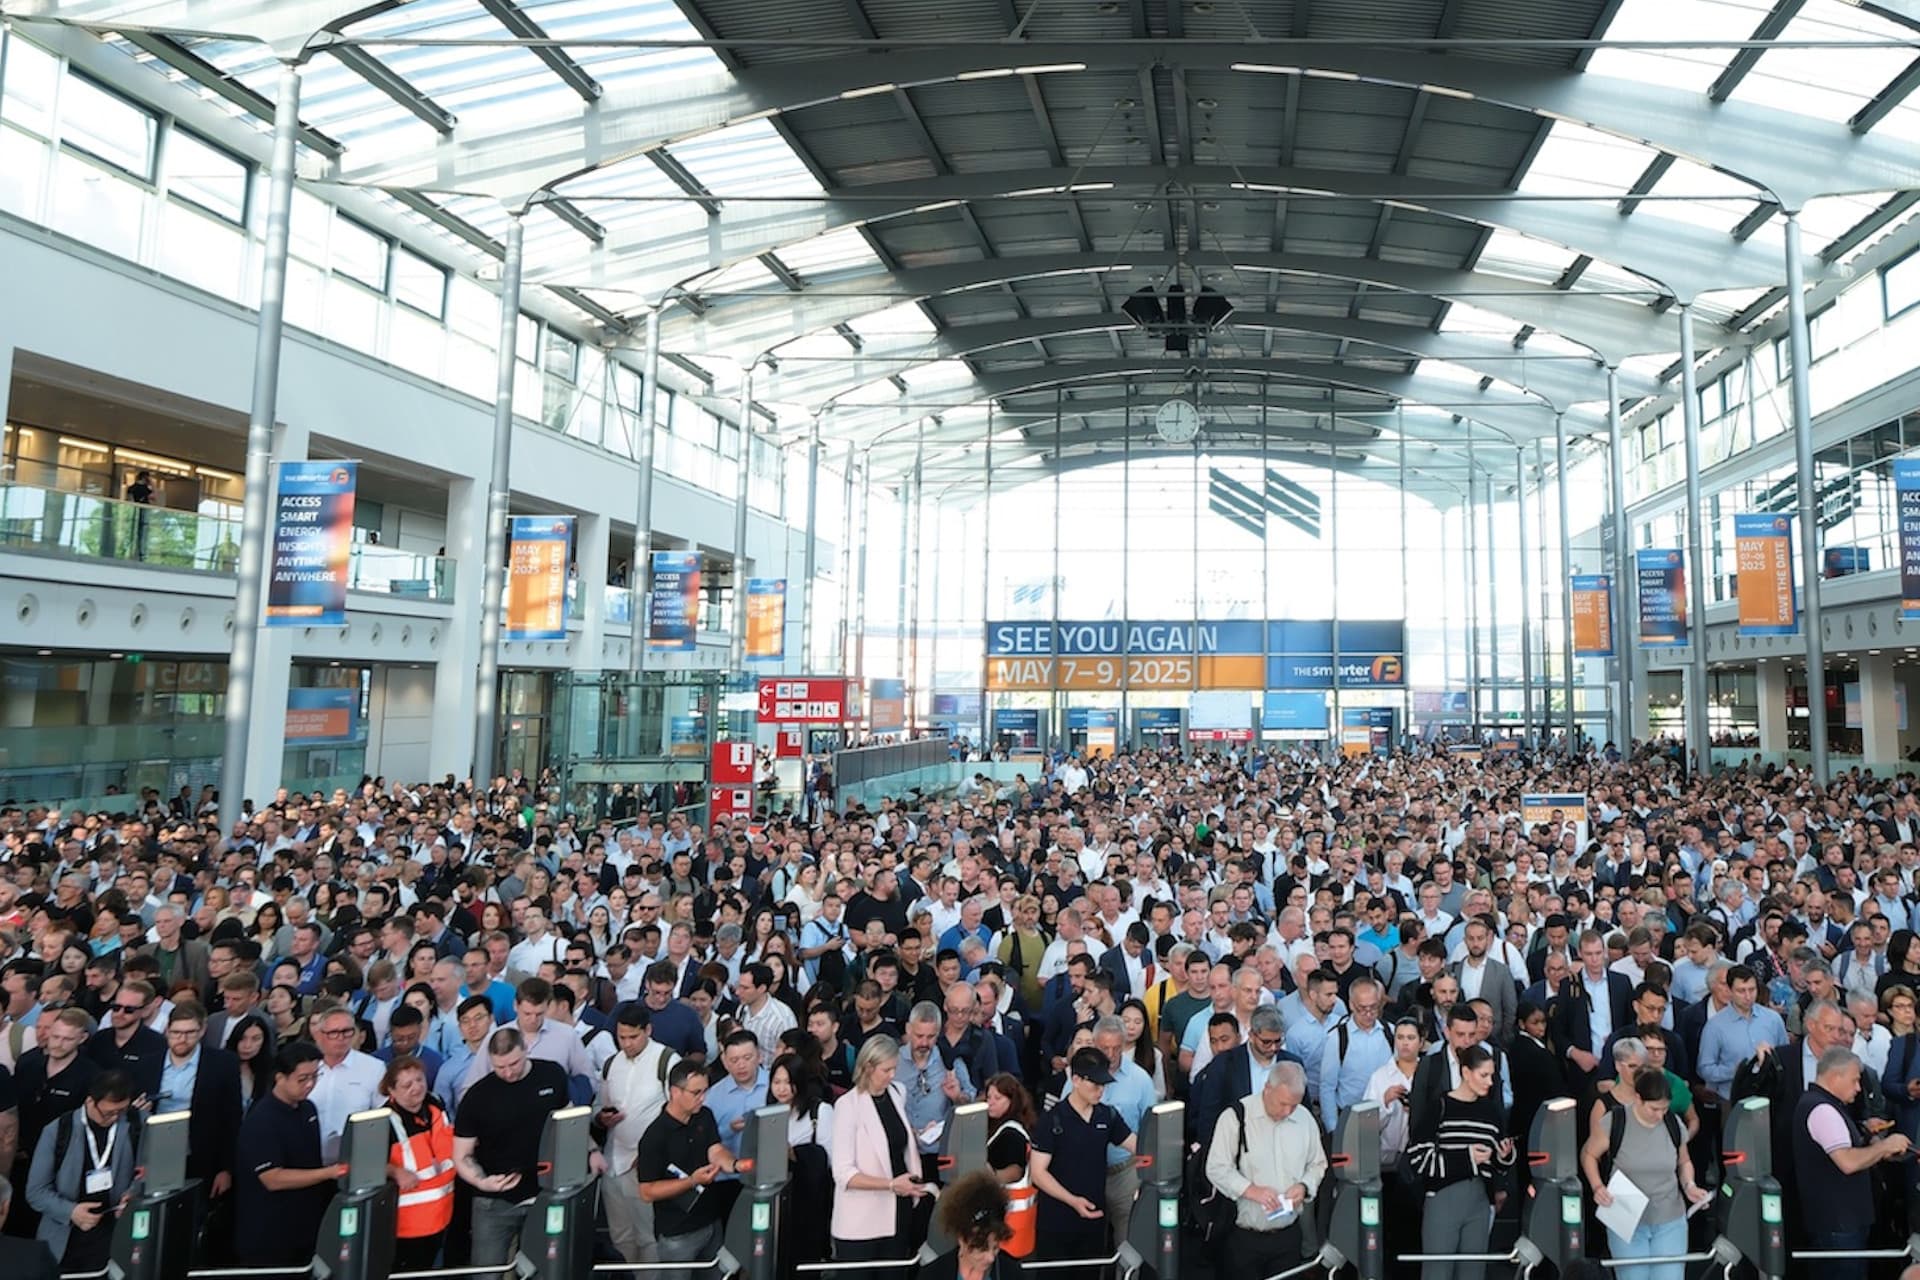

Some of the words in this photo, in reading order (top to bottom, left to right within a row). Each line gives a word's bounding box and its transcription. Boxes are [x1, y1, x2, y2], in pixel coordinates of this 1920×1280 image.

[281, 496, 322, 507] ACCESS
[280, 512, 318, 522] SMART
[279, 527, 322, 537] ENERGY
[516, 545, 540, 554] MAY
[1740, 542, 1764, 552] MAY
[1775, 541, 1786, 568] DATE
[1740, 561, 1766, 570] 2025
[274, 571, 336, 582] ANYWHERE
[1777, 570, 1787, 591] THE
[1778, 593, 1789, 621] SAVE
[996, 626, 1051, 652] SEE
[1057, 626, 1118, 652] YOU
[1126, 626, 1217, 651] AGAIN
[996, 660, 1052, 683] MAY
[1128, 660, 1191, 684] 2025
